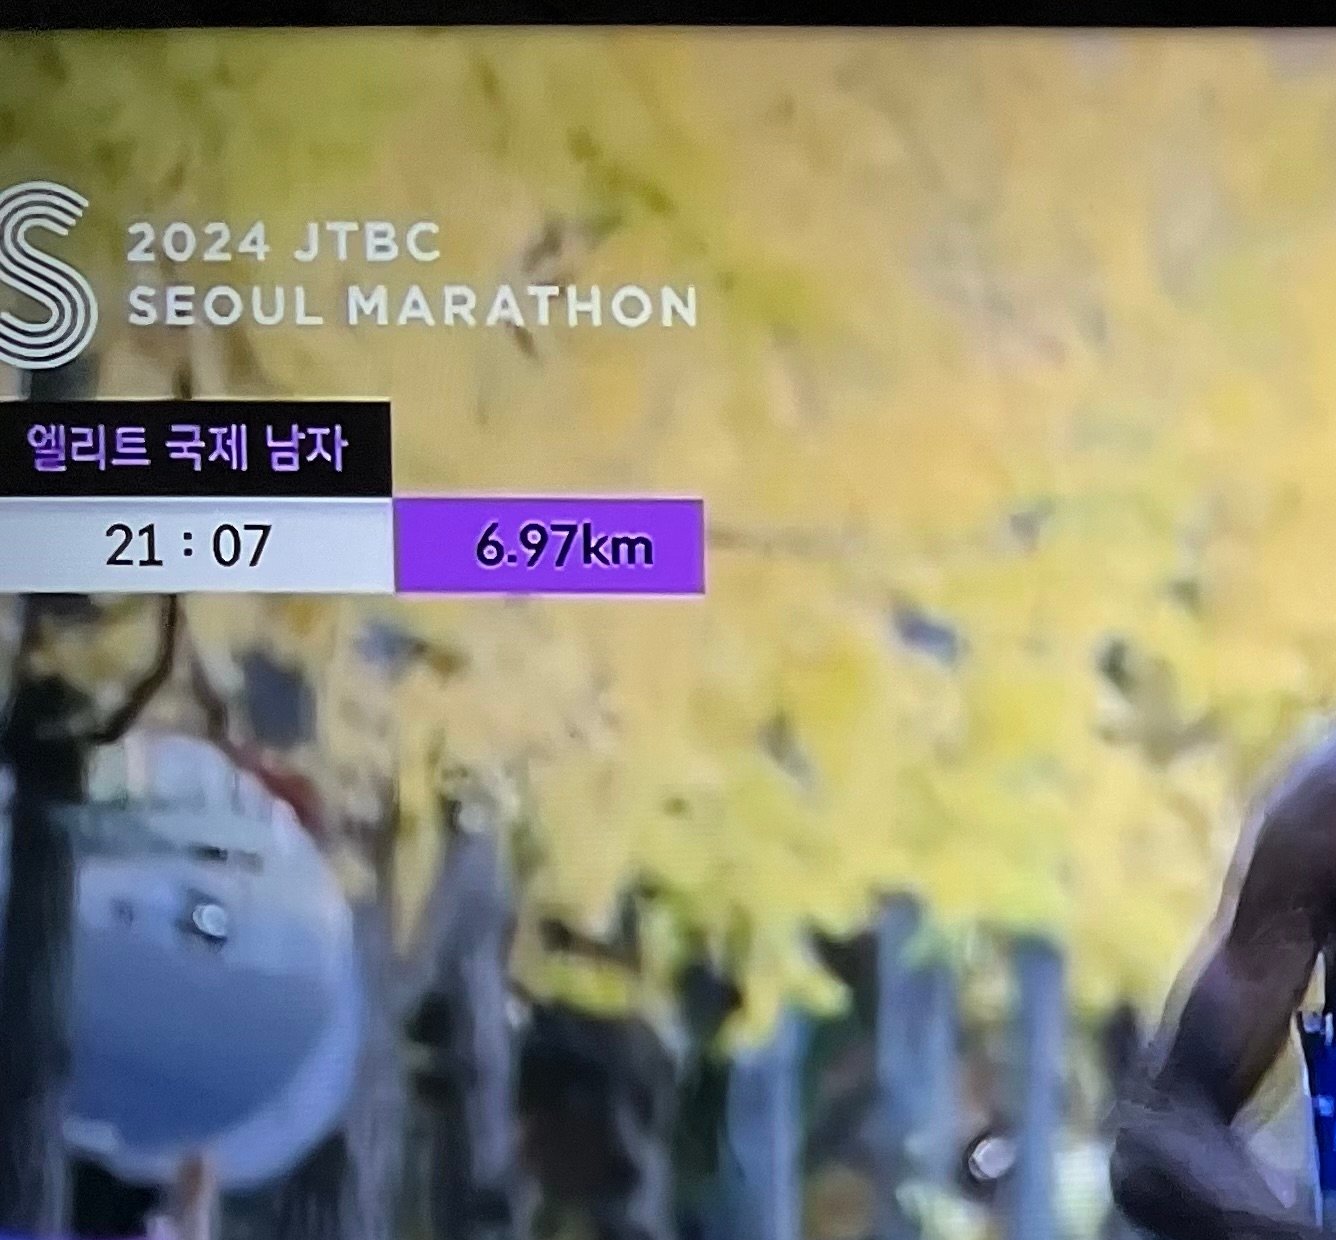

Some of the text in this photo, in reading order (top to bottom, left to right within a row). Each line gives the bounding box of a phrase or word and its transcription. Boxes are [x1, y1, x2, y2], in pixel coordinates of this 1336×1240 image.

[126, 220, 442, 264] 2024 JTBC
[126, 284, 698, 328] SEOUL MARATHON
[27, 422, 349, 473] 엘리트 국제 남자
[475, 521, 655, 569] 6.97km
